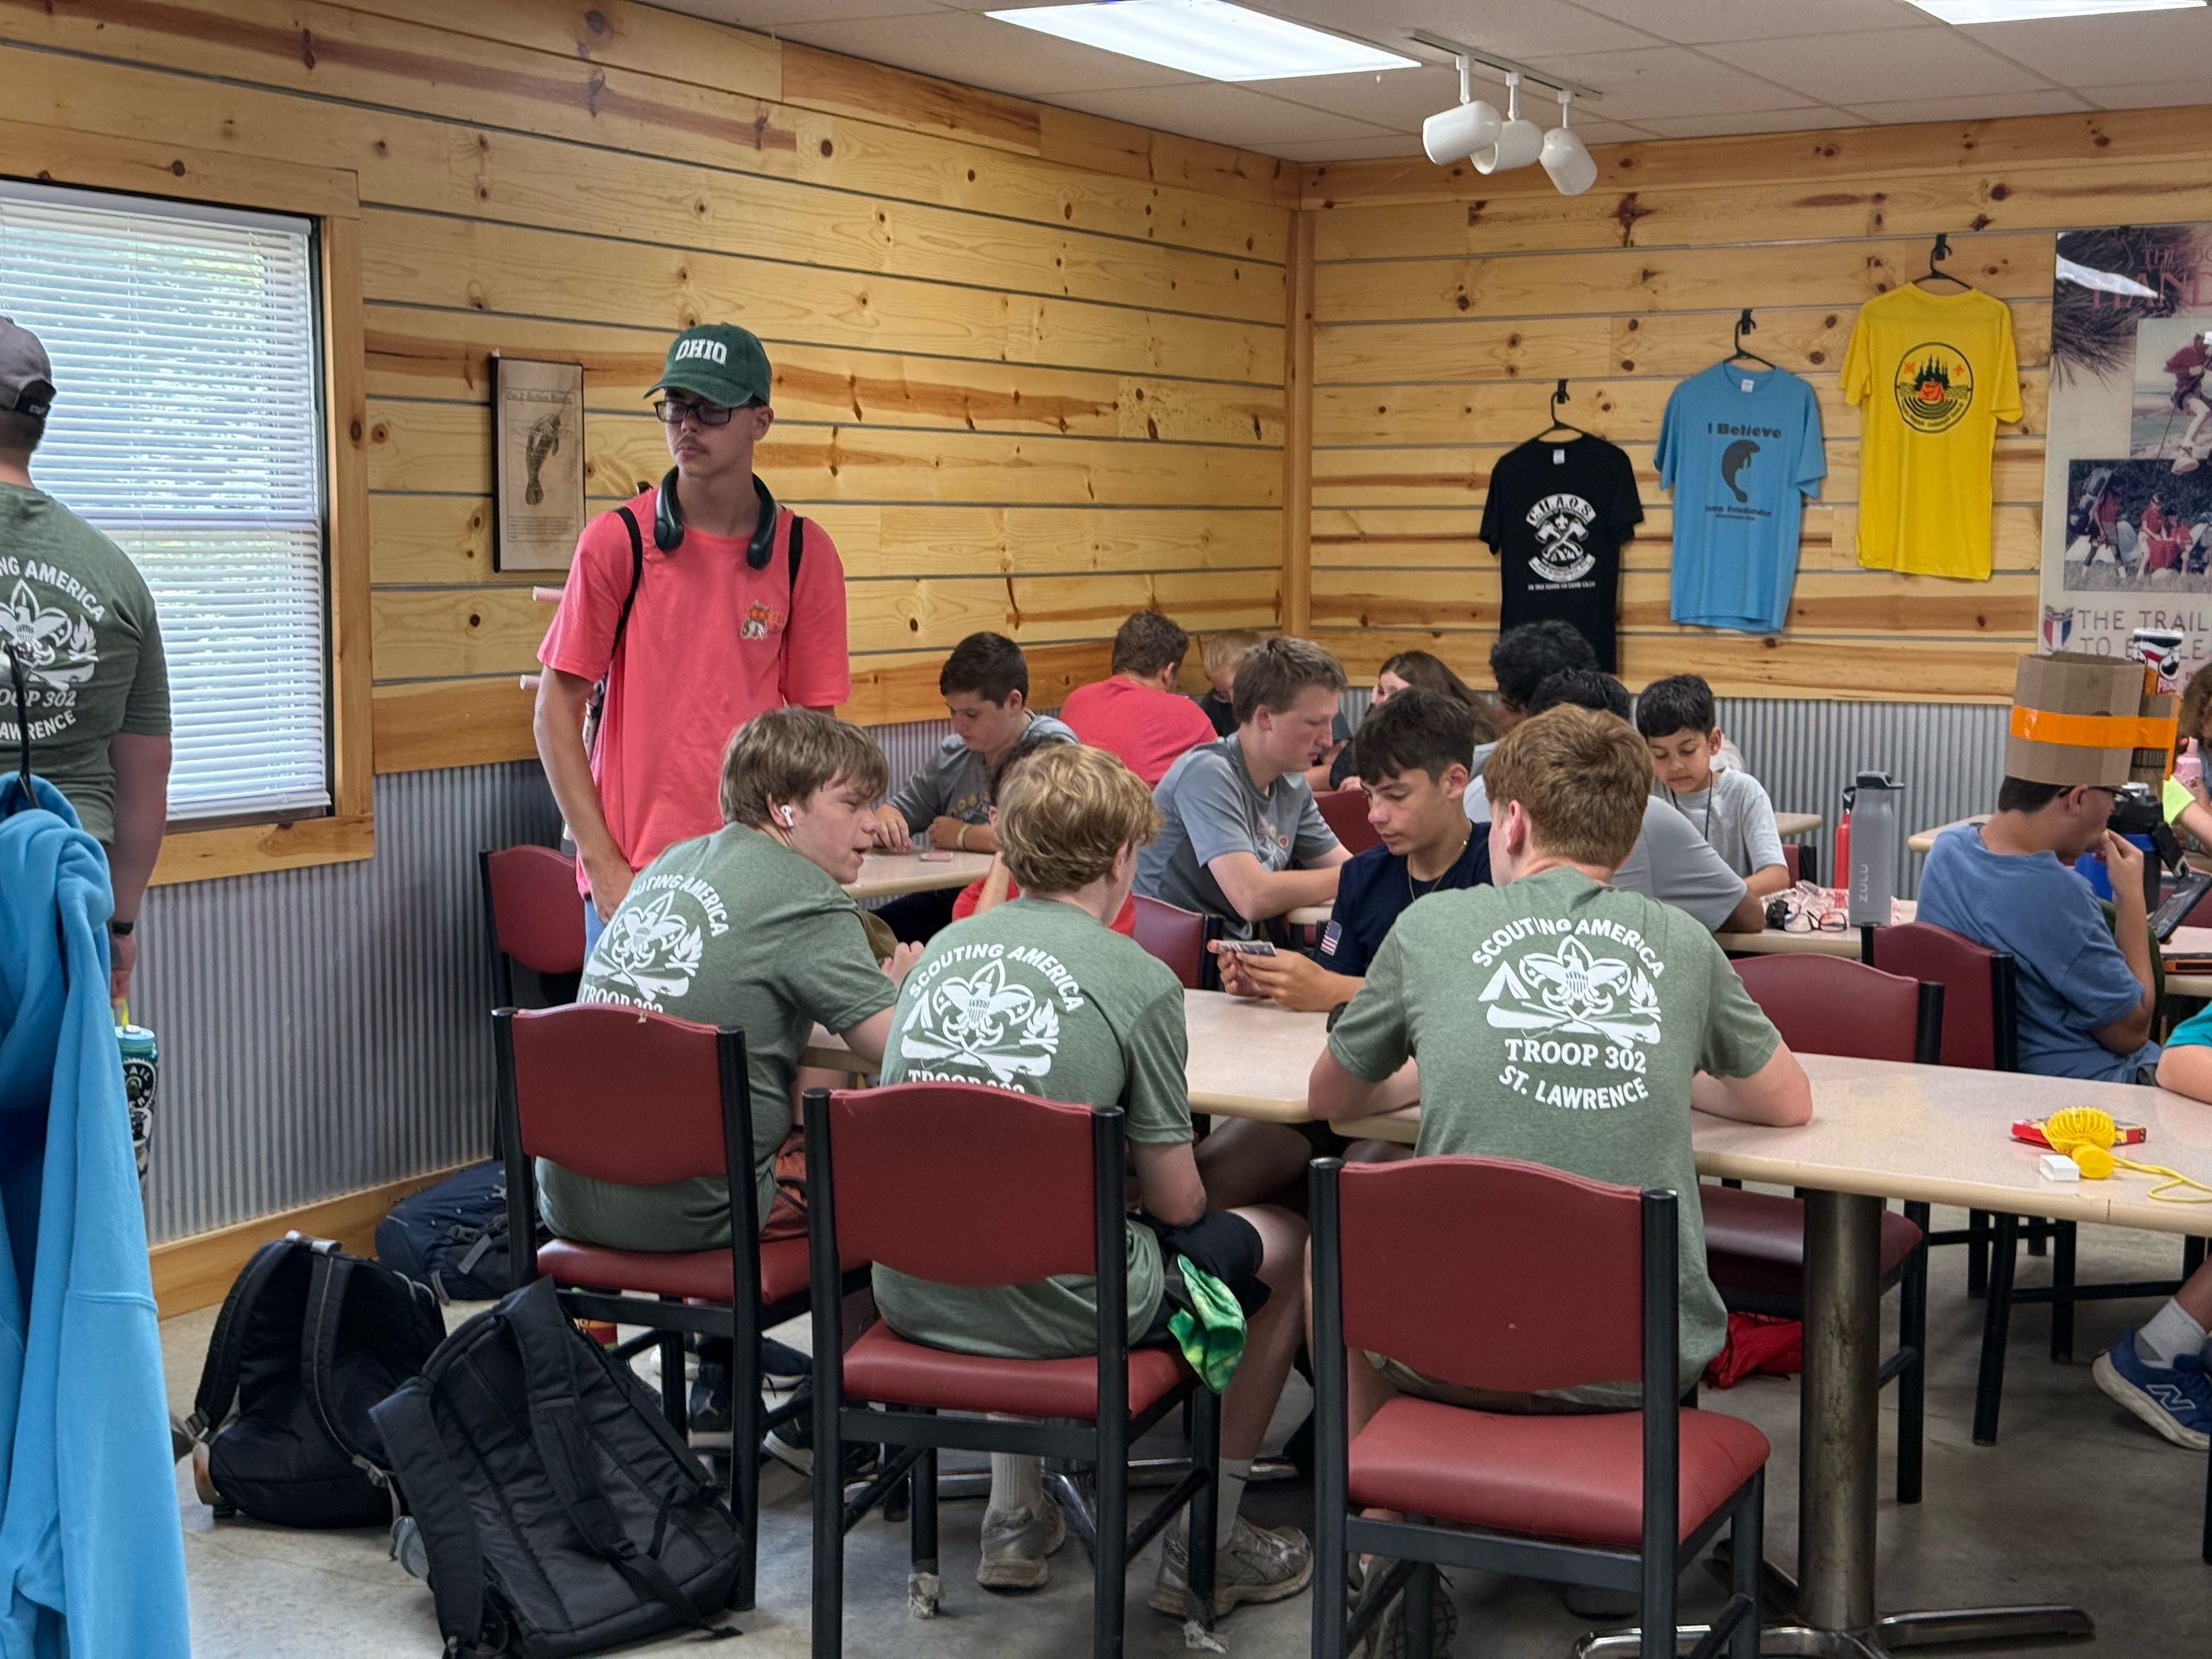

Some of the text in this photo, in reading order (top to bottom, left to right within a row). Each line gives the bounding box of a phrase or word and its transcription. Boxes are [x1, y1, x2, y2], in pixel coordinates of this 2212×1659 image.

[675, 339, 728, 366] OHIO
[1707, 422, 1782, 439] I Believe
[24, 559, 105, 622] AMERICA
[2077, 609, 2209, 632] THE TRAIL
[2079, 637, 2111, 657] TO
[42, 690, 77, 708] 302
[1859, 863, 1869, 904] ZULU
[678, 876, 729, 938] AMERICA
[1471, 916, 1665, 978] SCOUTING AMERICA
[909, 944, 1084, 1012] SCOUTING AMERICA
[1504, 1039, 1647, 1074] TROOP 302
[1498, 1065, 1649, 1110] ST. LAWRENCE
